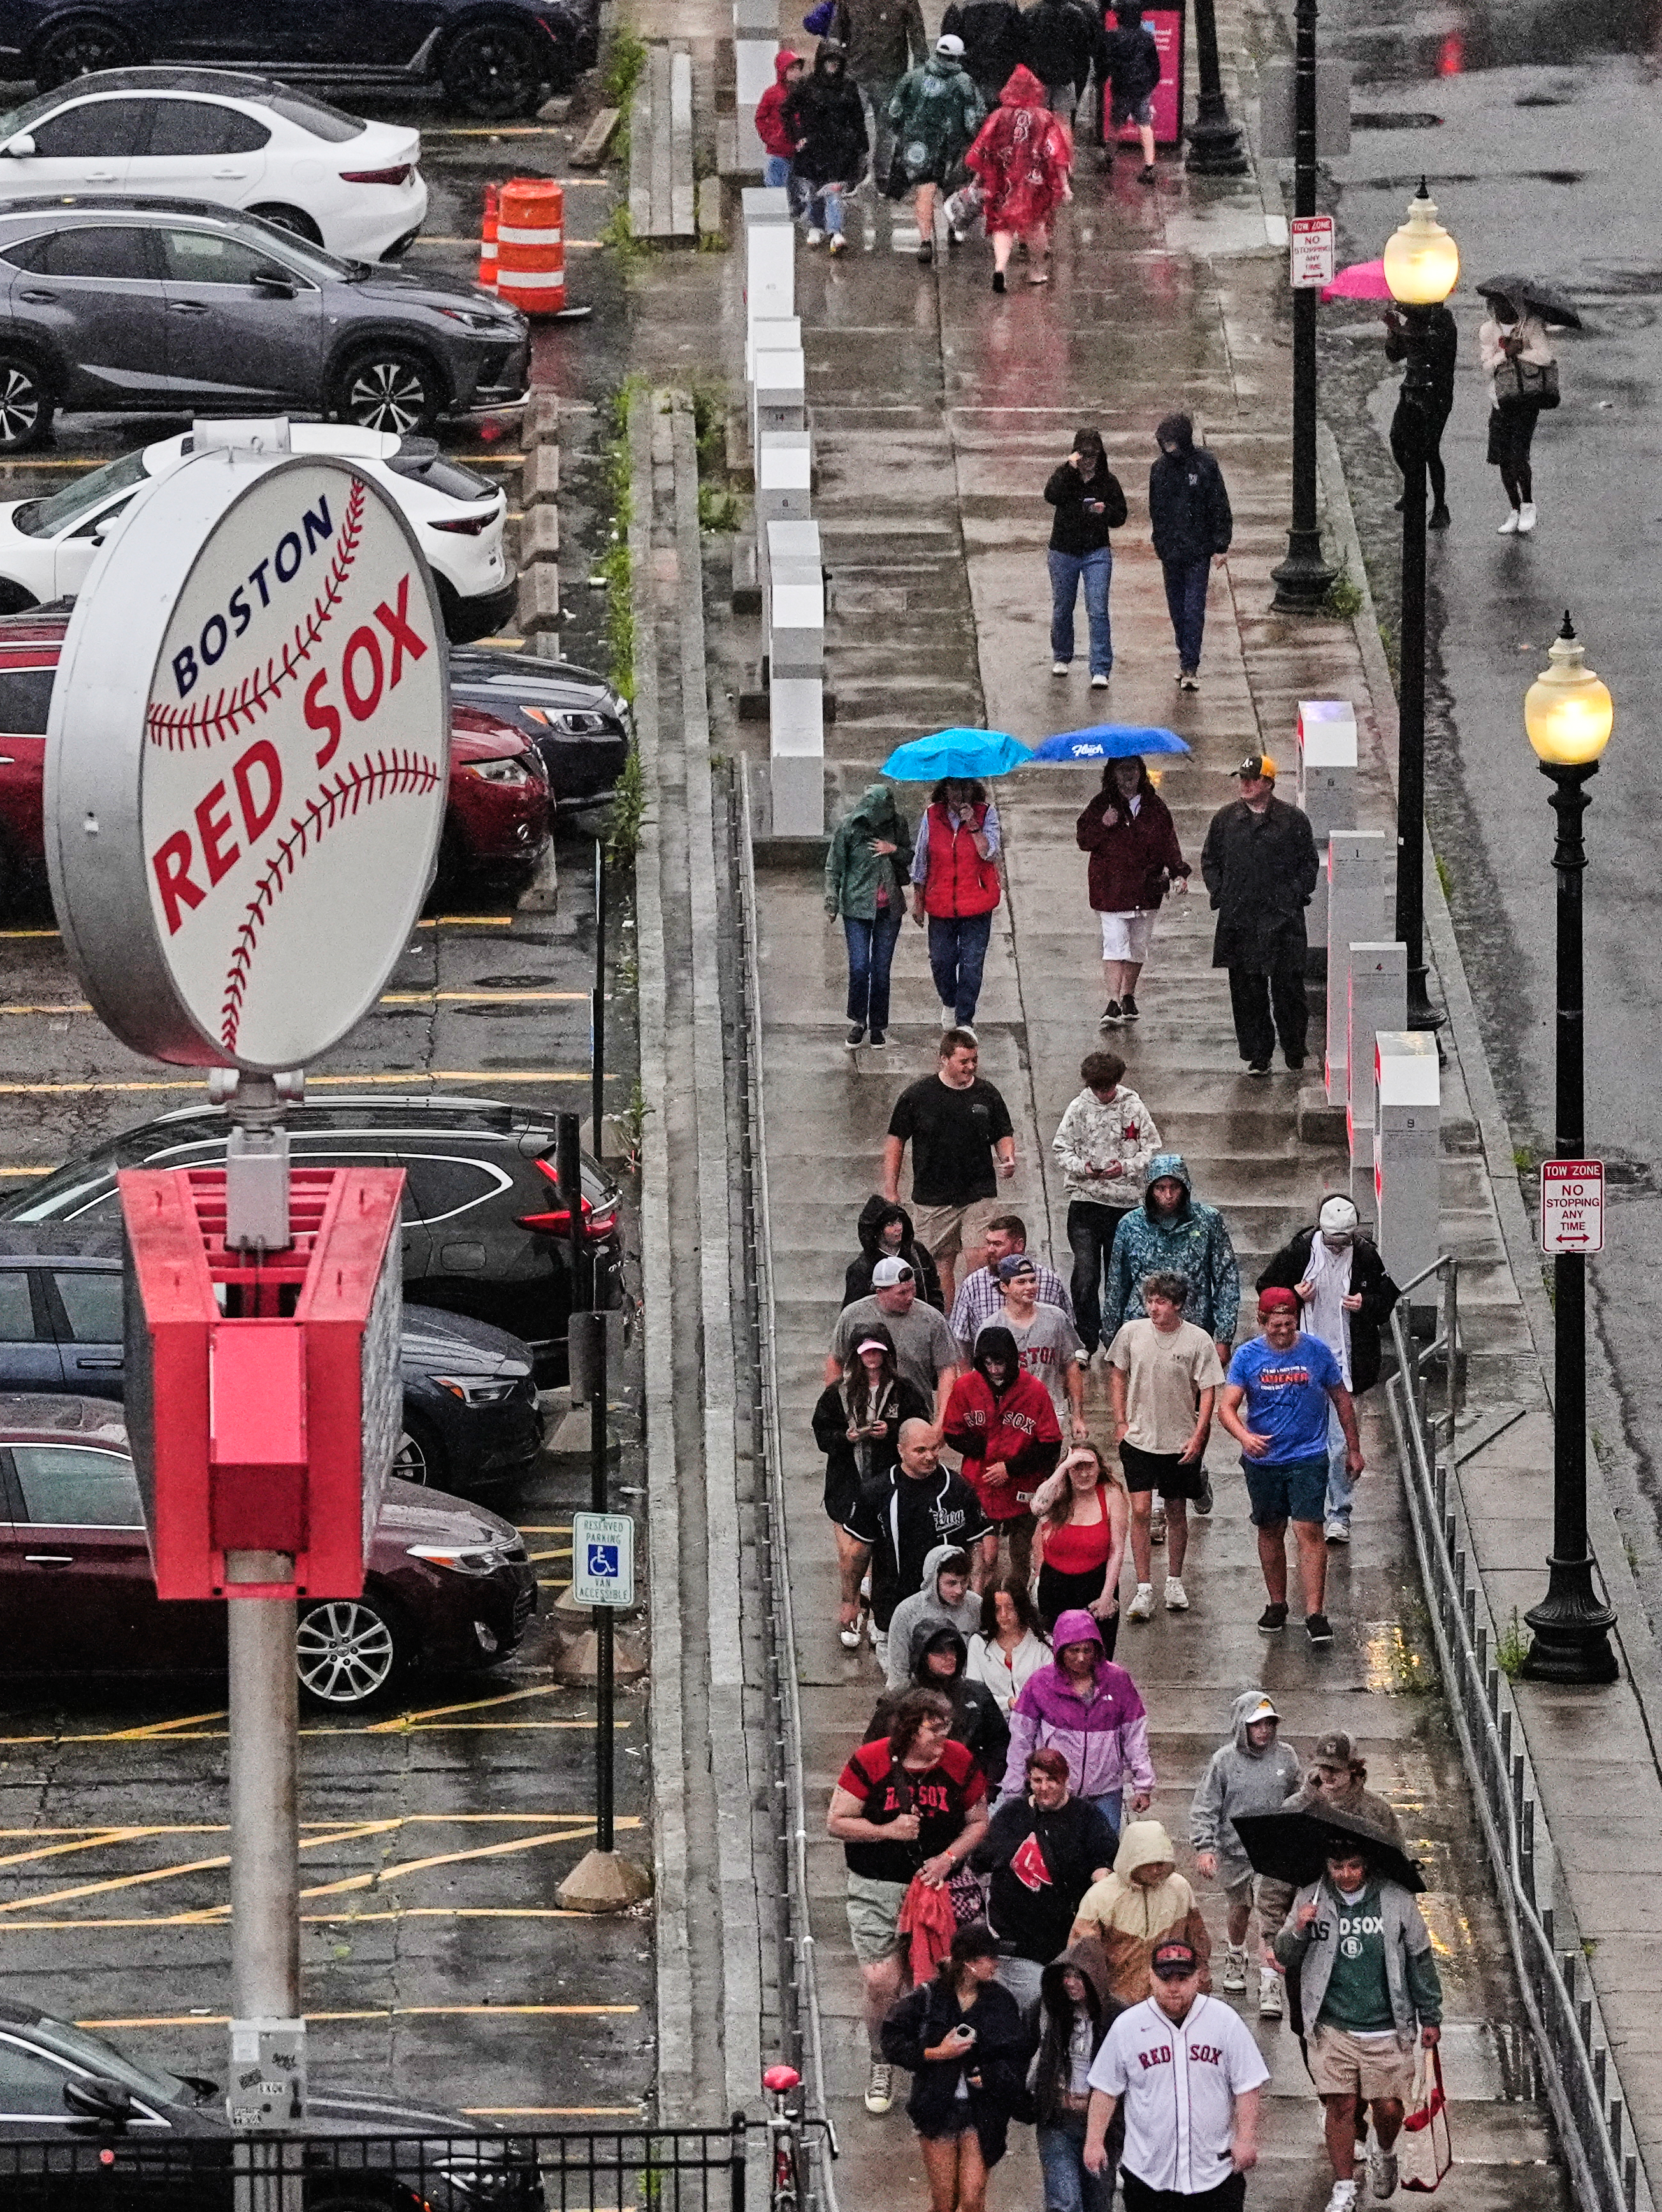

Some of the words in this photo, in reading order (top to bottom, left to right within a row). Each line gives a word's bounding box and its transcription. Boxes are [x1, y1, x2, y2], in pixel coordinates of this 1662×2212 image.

[1294, 222, 1309, 231] TOW
[1312, 220, 1331, 229] ZONE
[1304, 235, 1320, 245] NO
[1294, 245, 1331, 254] STOPPING
[172, 494, 333, 699] BOSTON
[152, 739, 282, 936] RED
[303, 573, 428, 770] SOX
[1375, 963, 1383, 971] 4
[1546, 1166, 1567, 1176] TOW
[1572, 1165, 1600, 1176] ZONE
[1562, 1185, 1584, 1196] NO
[1546, 1197, 1600, 1208] STOPPING
[1561, 1210, 1584, 1218] ANY
[1561, 1222, 1586, 1231] TIME
[1002, 1410, 1036, 1435] SOX
[584, 1519, 623, 1533] RESERVED
[586, 1533, 621, 1544] PARKING
[595, 1578, 611, 1587] VAN
[579, 1587, 628, 1600] ACCESSIBLE
[919, 1786, 950, 1812] SOX
[1138, 2045, 1171, 2071] RED
[1189, 2044, 1222, 2066] SOX
